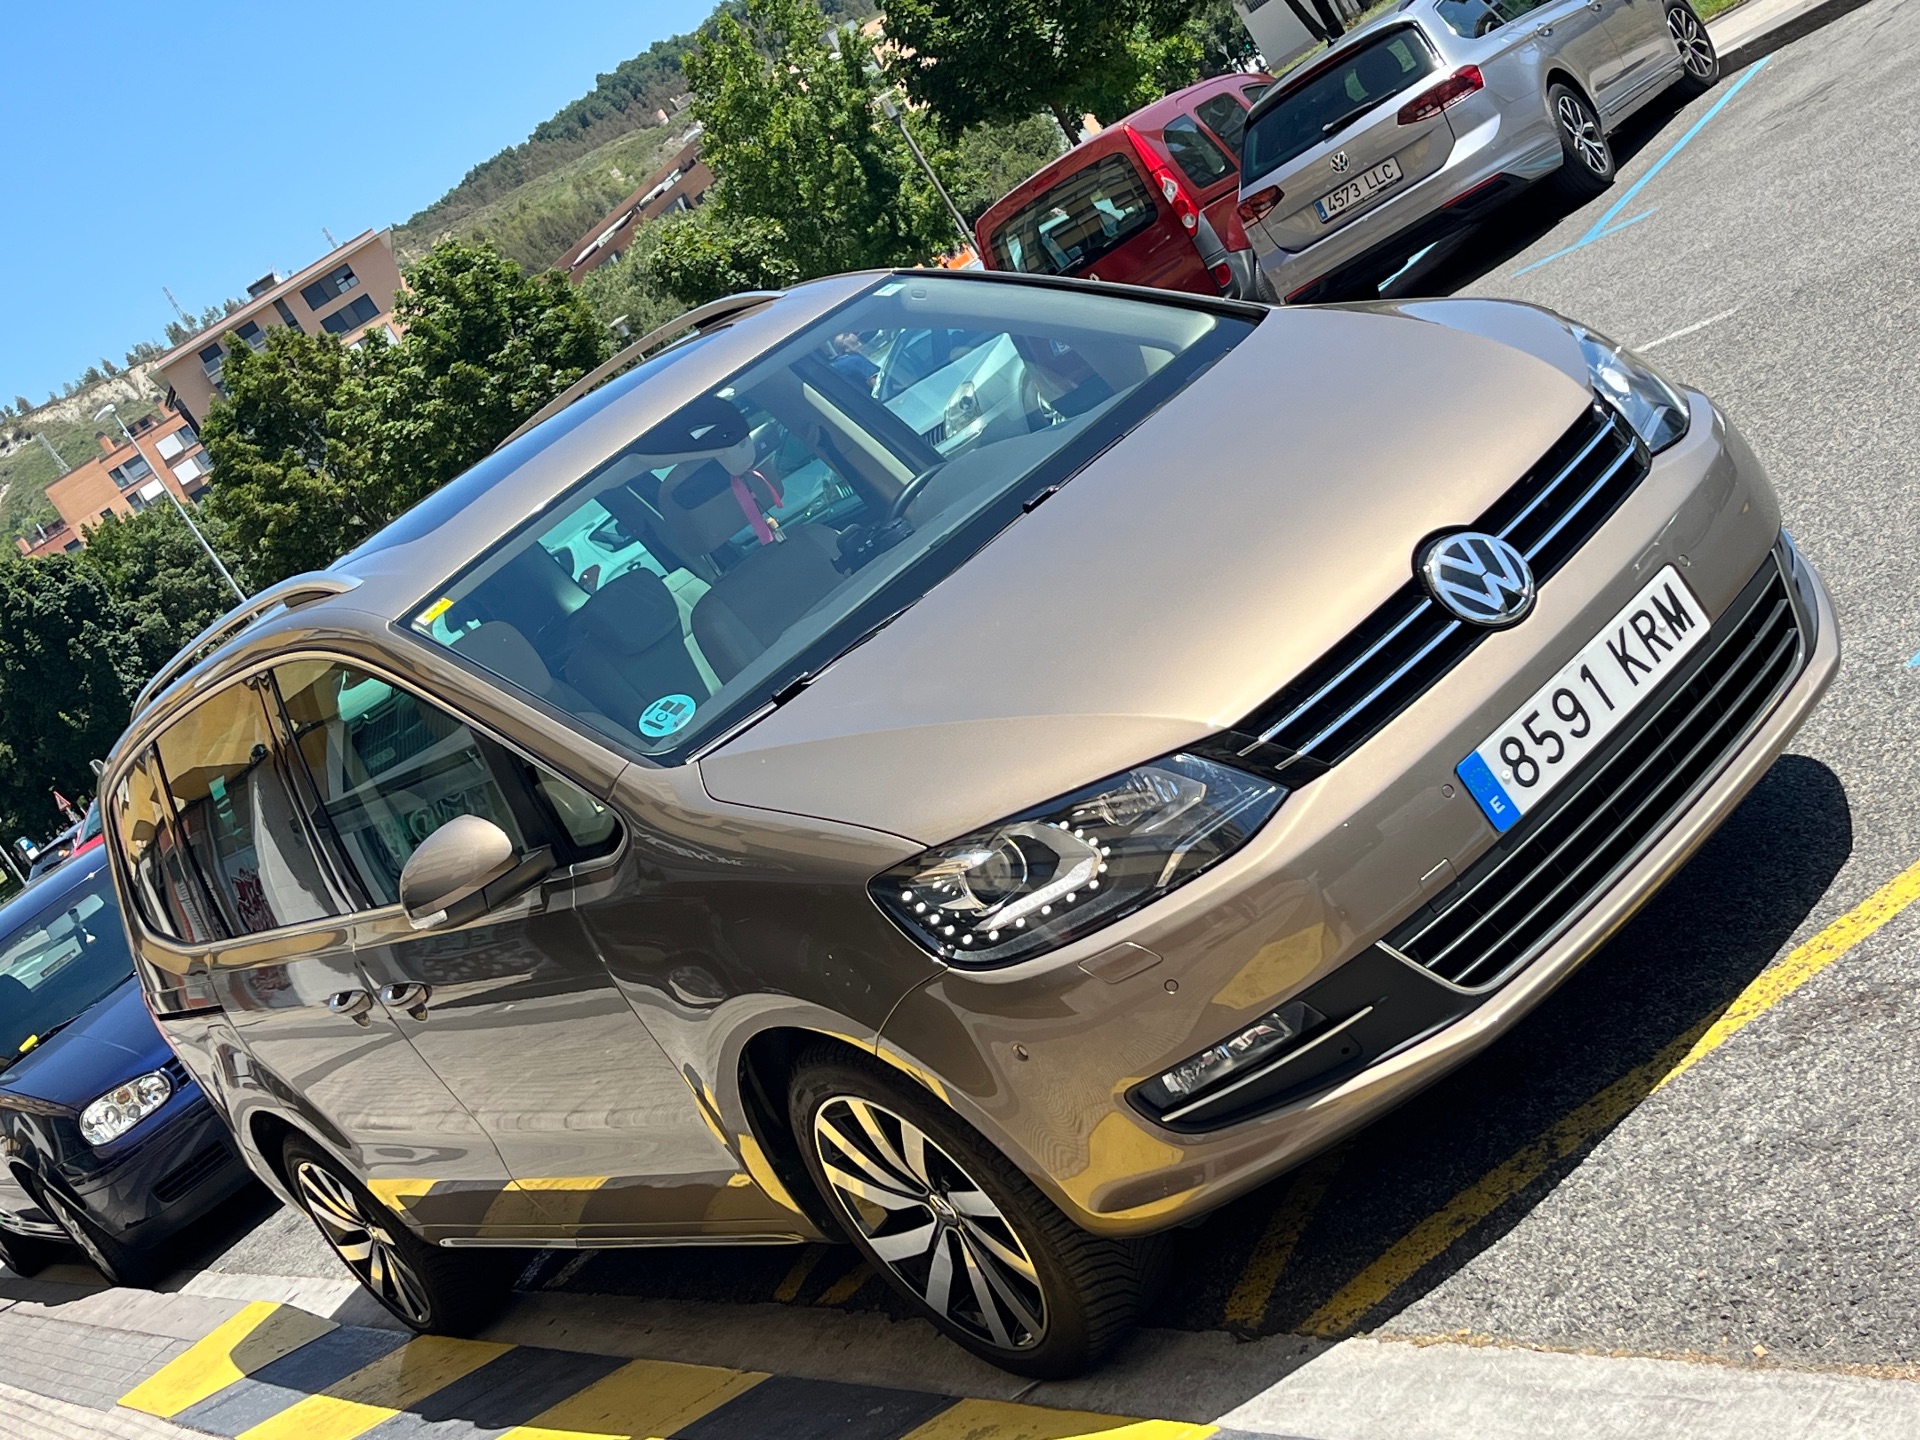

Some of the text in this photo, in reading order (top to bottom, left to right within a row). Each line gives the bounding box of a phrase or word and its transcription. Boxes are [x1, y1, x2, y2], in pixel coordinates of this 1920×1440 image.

[1328, 183, 1361, 212] 4573
[1364, 164, 1394, 190] LLC
[1500, 582, 1696, 788] 8591 KRM
[1489, 795, 1505, 814] E
